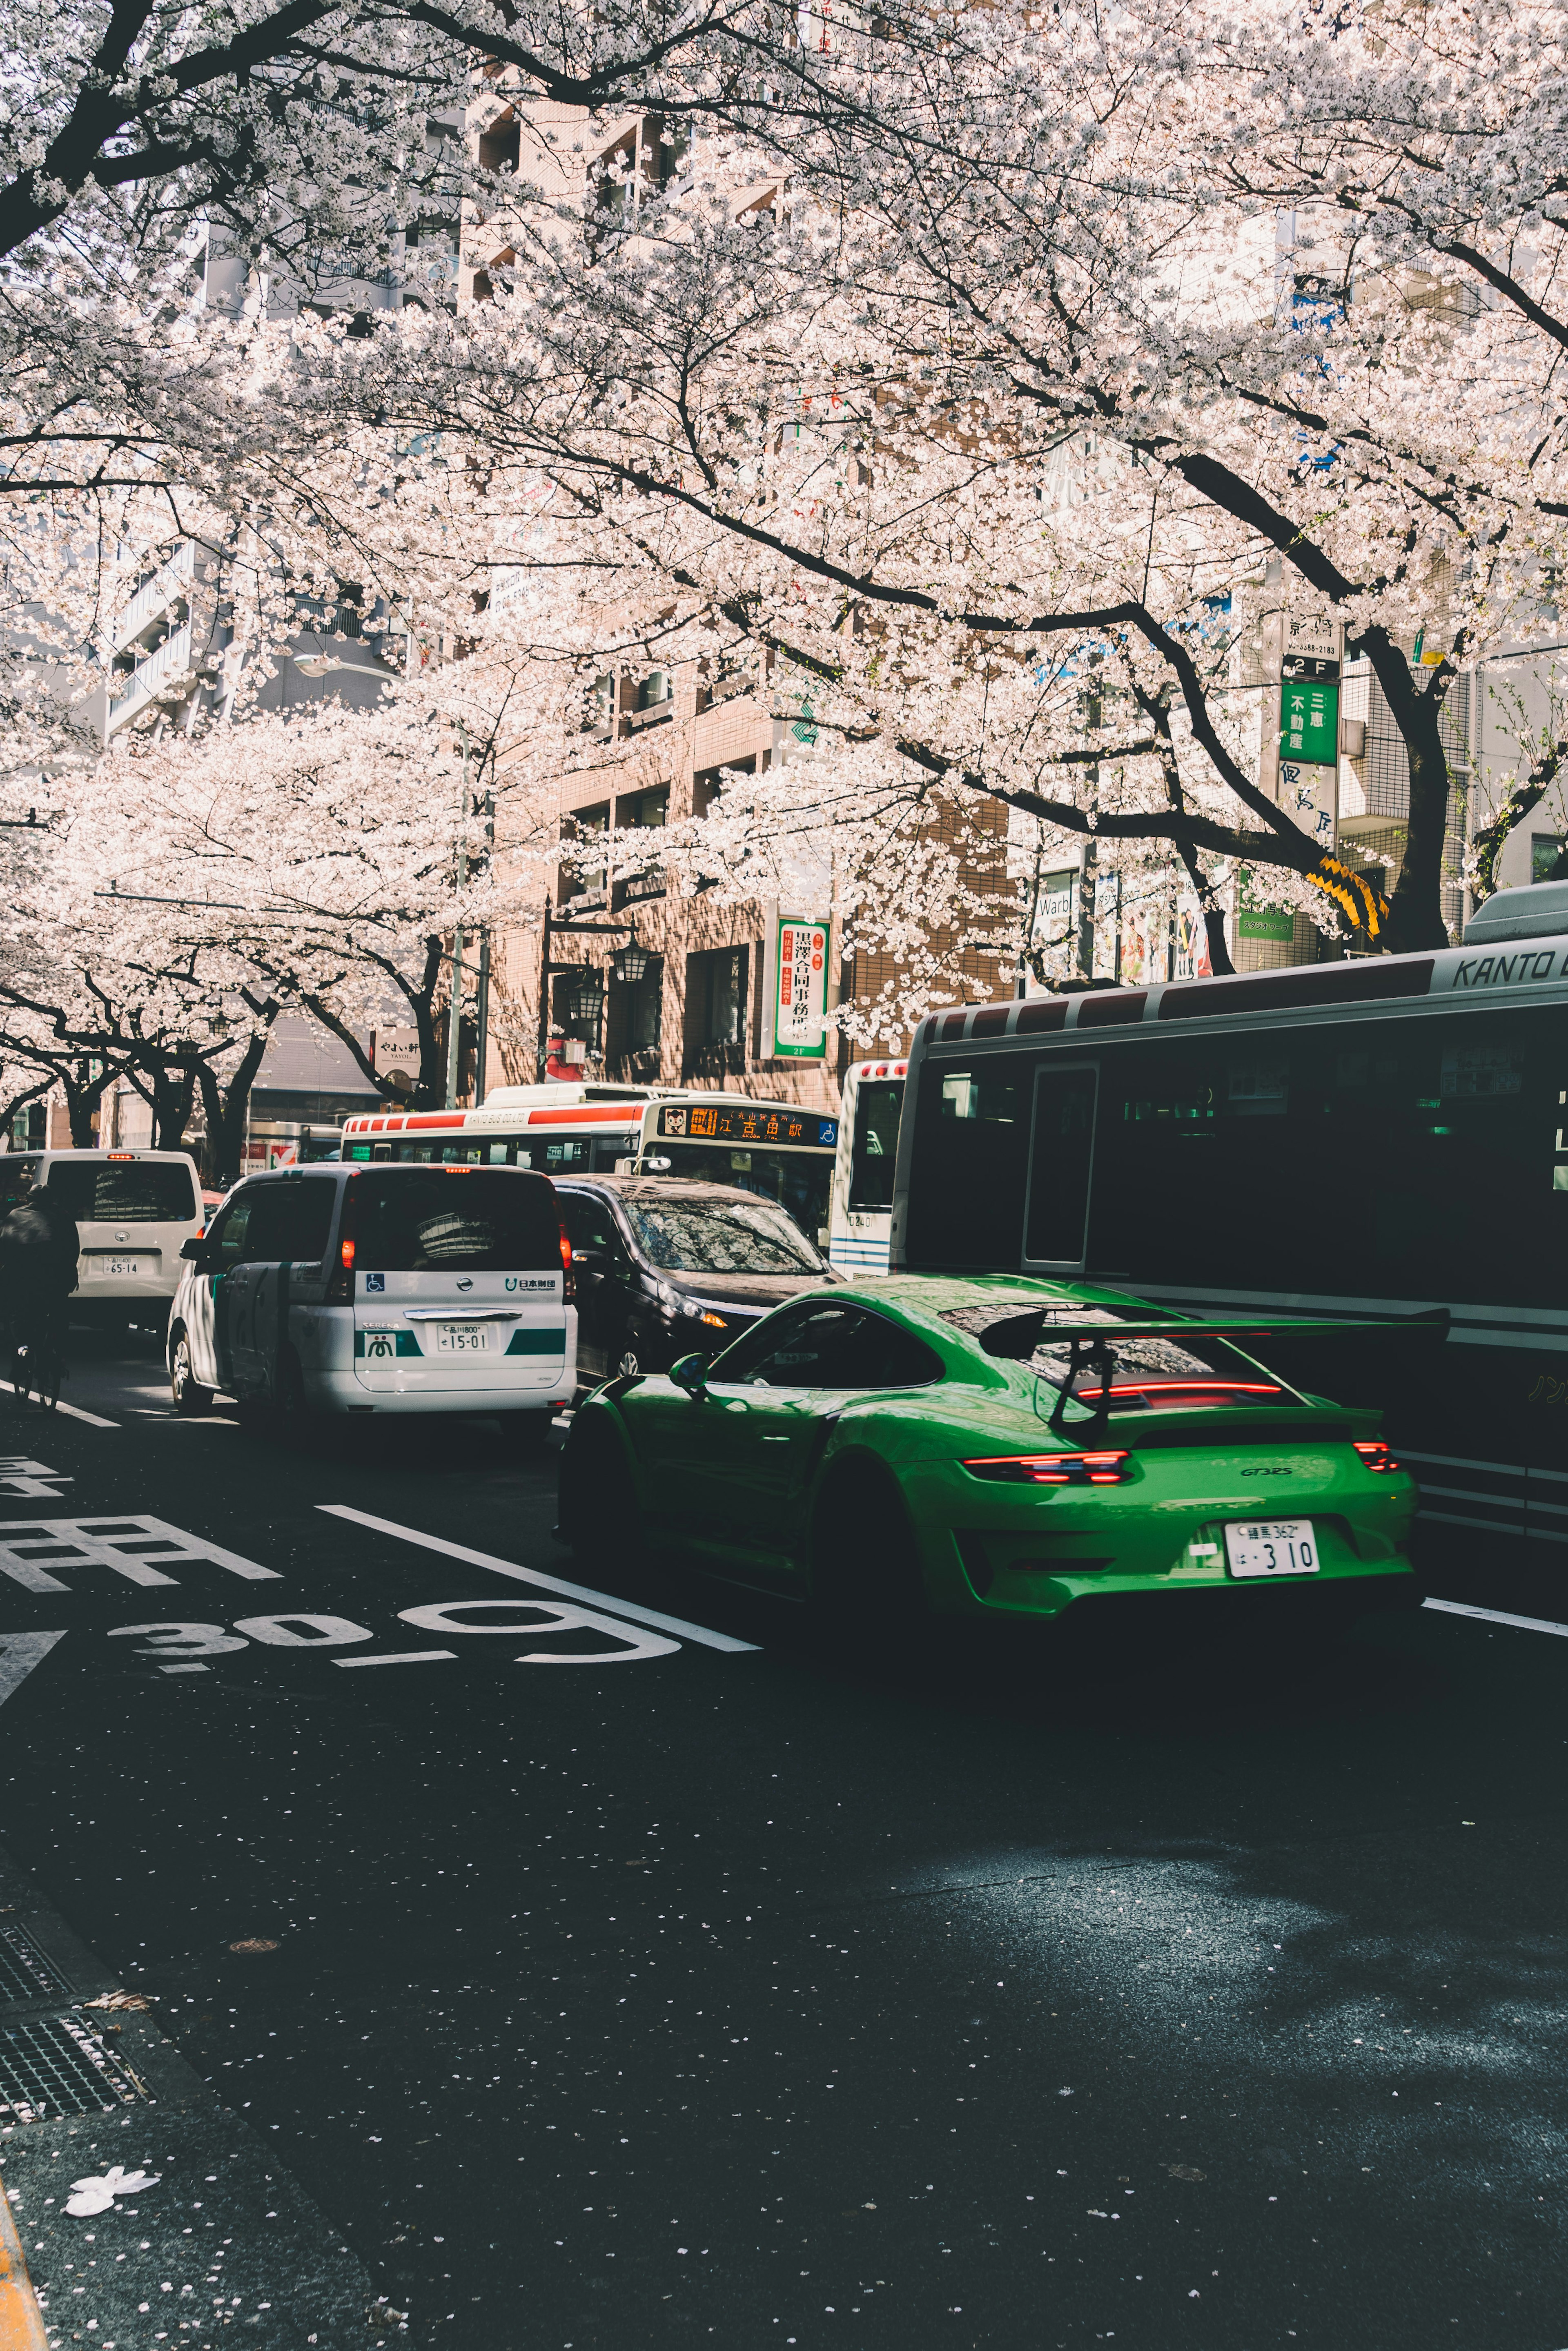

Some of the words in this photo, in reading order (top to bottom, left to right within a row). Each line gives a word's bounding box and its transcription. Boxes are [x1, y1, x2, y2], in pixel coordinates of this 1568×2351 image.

[1289, 695, 1305, 749] 不動産
[1310, 693, 1324, 727] 三恵
[1040, 895, 1069, 916] Warb
[784, 932, 792, 960] 司法書士
[1452, 951, 1555, 987] KANTO
[381, 1042, 419, 1054] やよい軒
[719, 1118, 802, 1137] 江古田駅
[111, 1264, 137, 1273] 65-14
[451, 1335, 485, 1348] 15-01
[1528, 1375, 1568, 1405] ノン
